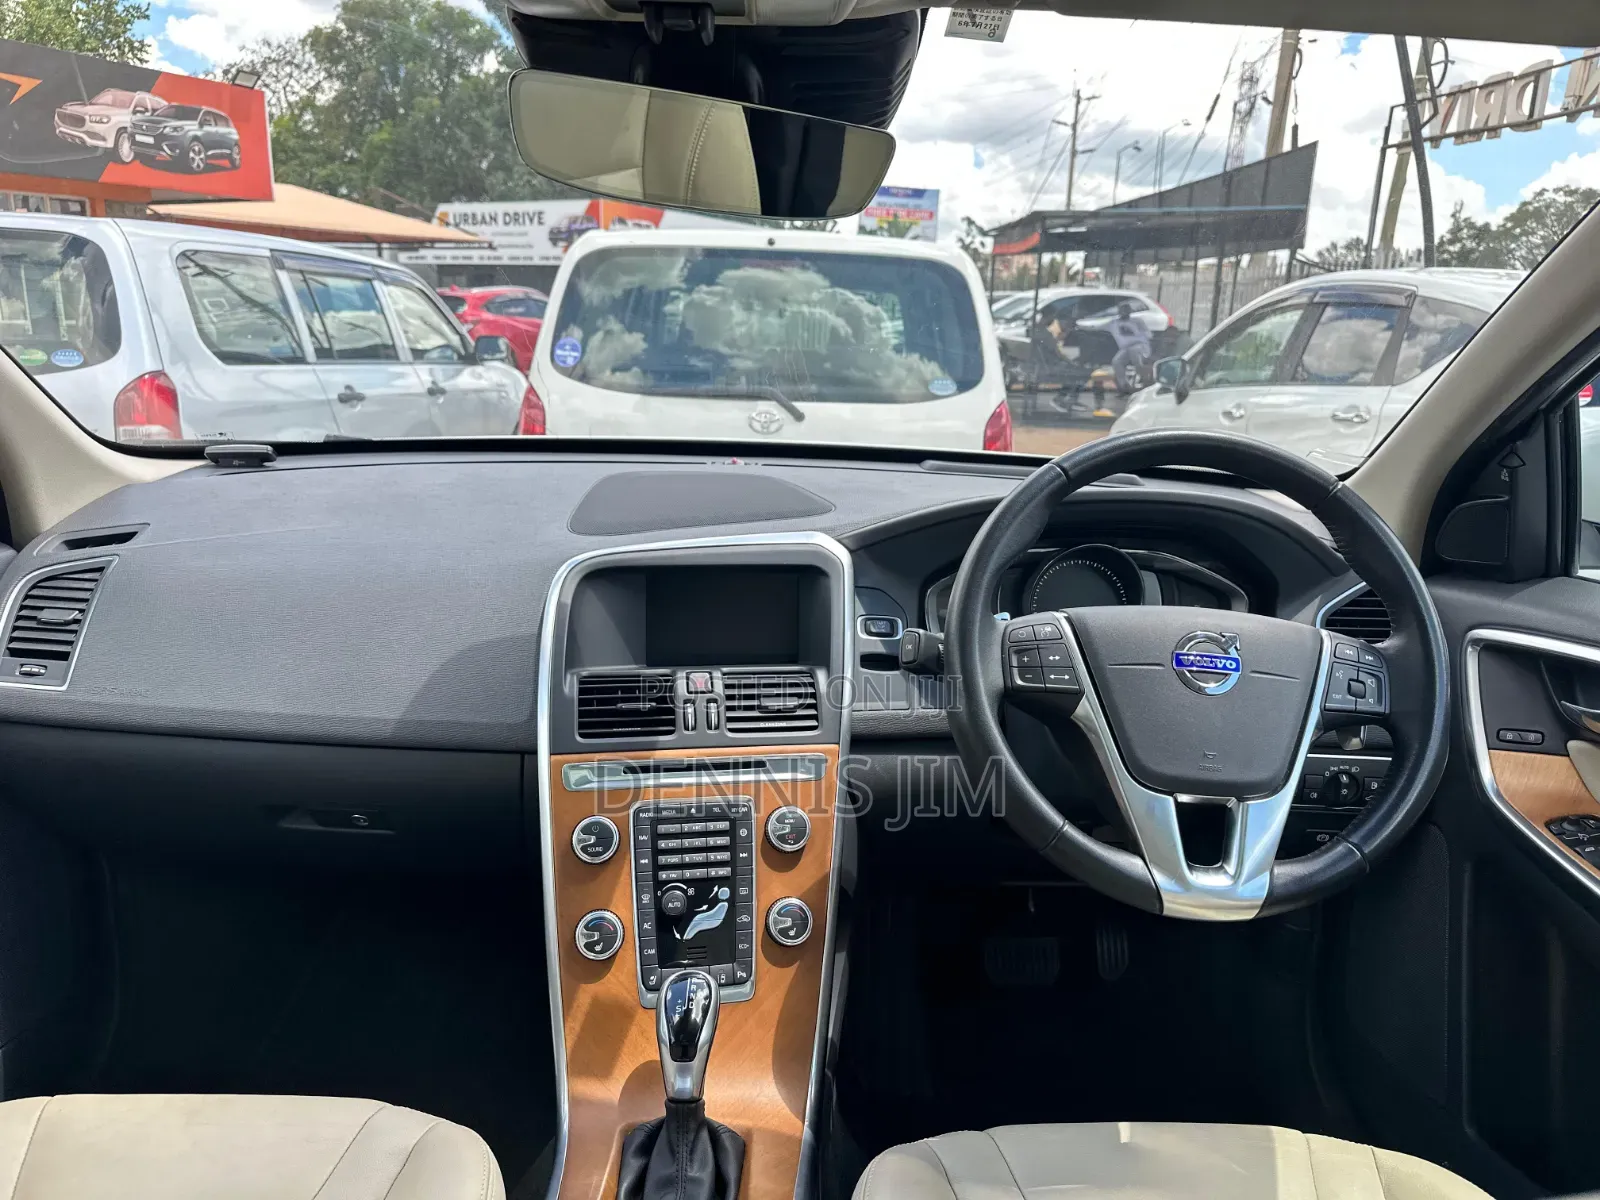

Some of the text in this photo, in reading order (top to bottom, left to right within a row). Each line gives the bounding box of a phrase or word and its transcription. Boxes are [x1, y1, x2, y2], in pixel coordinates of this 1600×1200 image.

[452, 210, 544, 226] URBAN DRIVE
[1179, 656, 1236, 669] VOLVO
